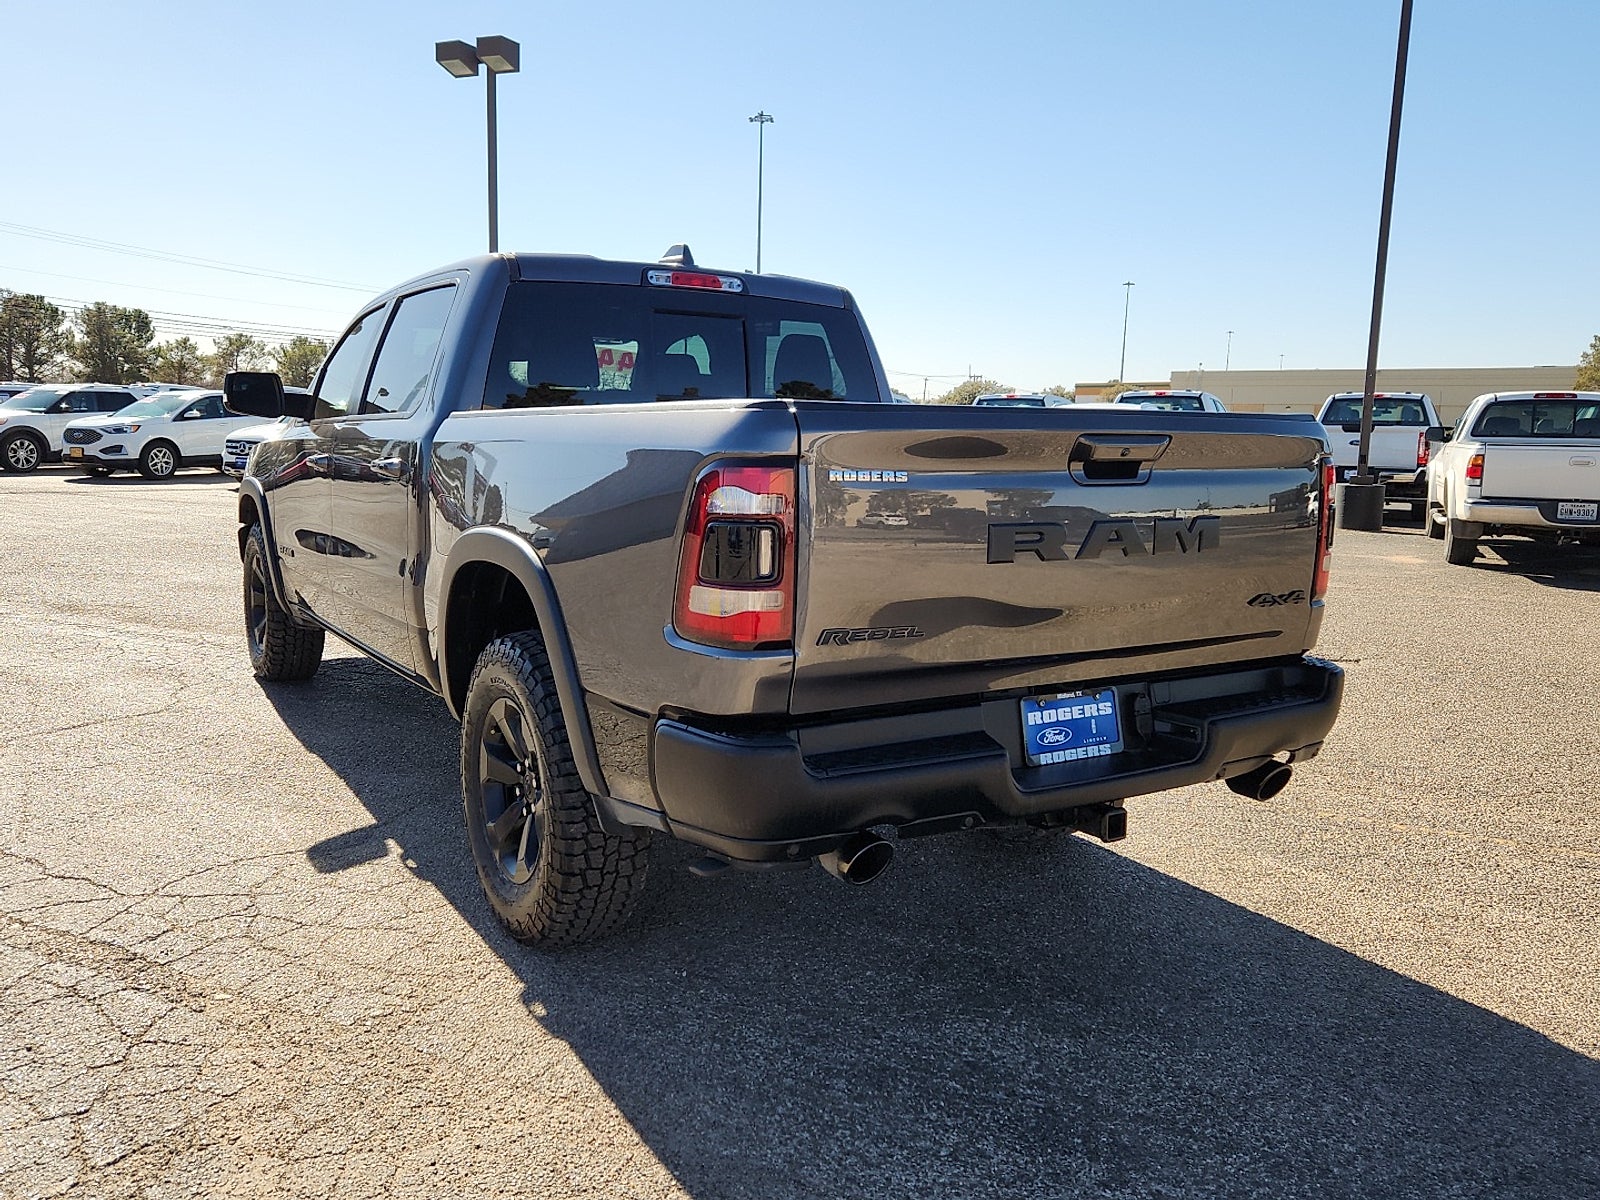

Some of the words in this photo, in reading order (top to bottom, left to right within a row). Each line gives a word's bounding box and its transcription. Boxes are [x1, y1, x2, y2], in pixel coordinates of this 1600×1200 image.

[828, 469, 909, 482] ROGERS
[986, 515, 1221, 564] RAM
[816, 625, 925, 647] REBEL
[1028, 702, 1112, 725] ROGERS
[1043, 729, 1066, 743] Ford
[1040, 744, 1111, 764] ROGERS
